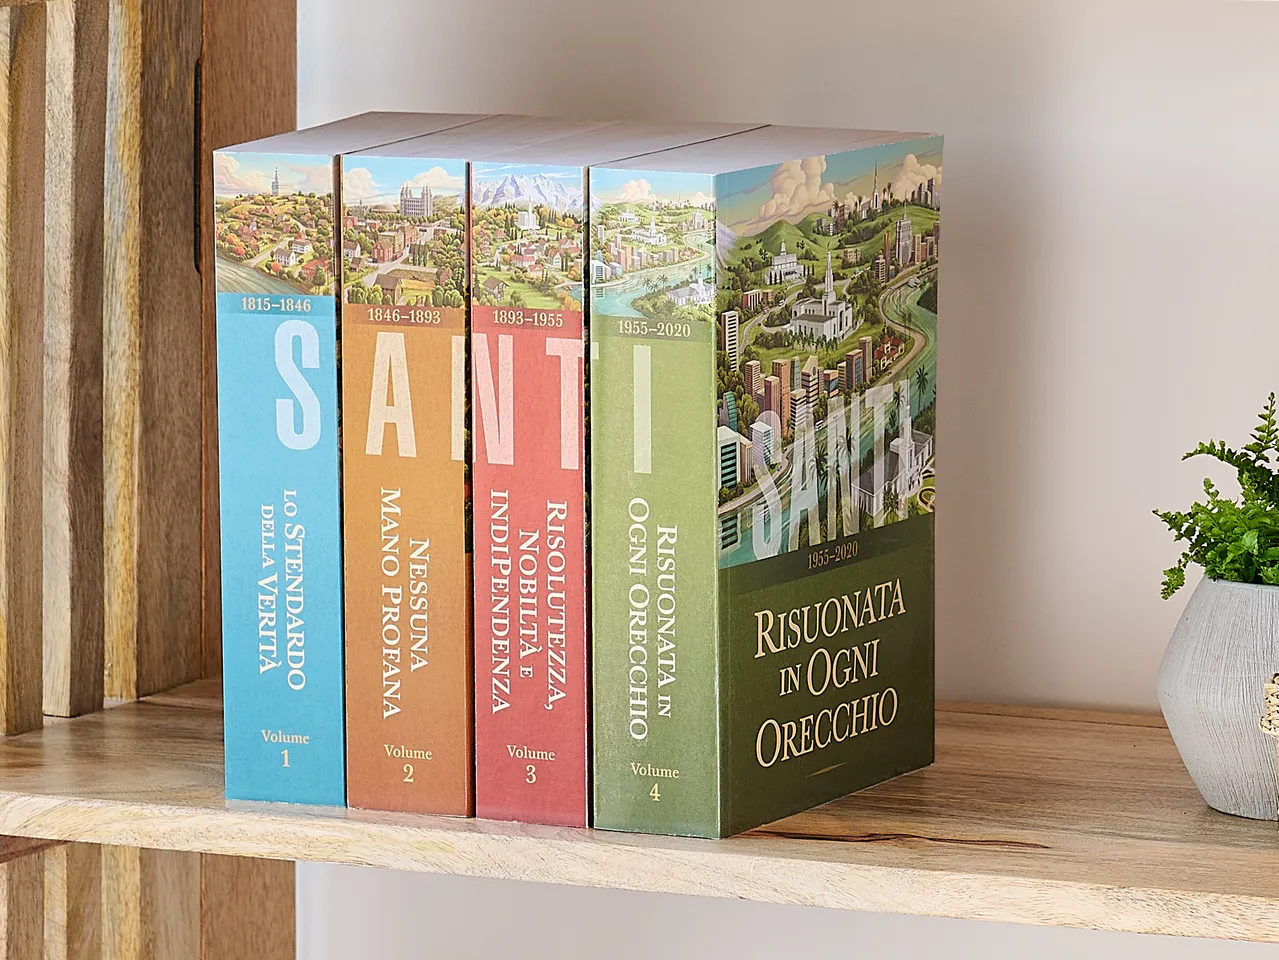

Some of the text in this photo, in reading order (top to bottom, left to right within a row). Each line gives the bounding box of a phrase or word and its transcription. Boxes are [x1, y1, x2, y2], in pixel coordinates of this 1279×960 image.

[751, 378, 910, 561] SANTI
[258, 504, 282, 674] DELLA VERITÀ
[284, 489, 306, 691] LO STENDARDO
[381, 487, 402, 719] MANO PROFANA
[409, 538, 429, 672] NESSUNA
[490, 489, 512, 714] INDIPENDENZA
[519, 528, 543, 678] NOBILTÀ E
[544, 500, 568, 711] RISOLUTEZZA,
[628, 497, 650, 740] OGNI ORECCHIO
[657, 525, 678, 718] RISUONATA IN
[754, 578, 906, 658] RISUONATA
[779, 640, 880, 697] IN OGNI
[261, 729, 310, 744] Volume
[281, 749, 291, 768] 1
[383, 744, 432, 760] Volume
[506, 745, 556, 761] Volume
[755, 687, 899, 769] ORECCHIO
[402, 764, 414, 783] 2
[525, 765, 537, 784] 3
[630, 762, 679, 779] Volume
[649, 783, 661, 801] 4
